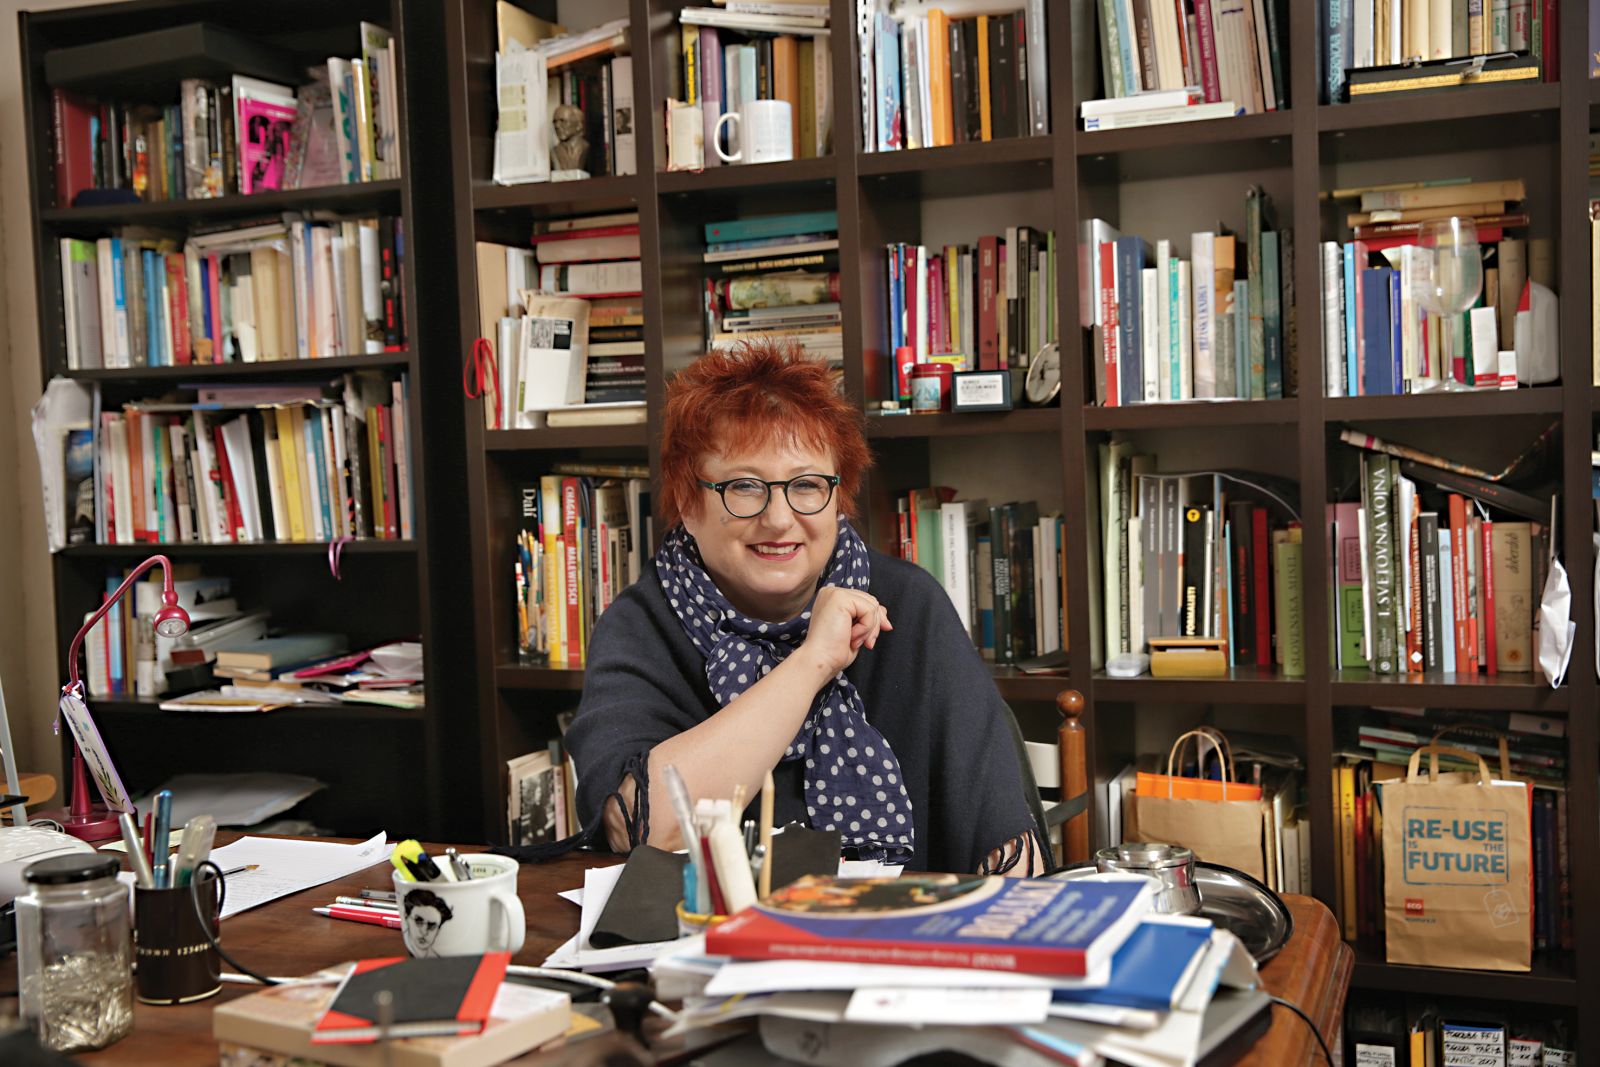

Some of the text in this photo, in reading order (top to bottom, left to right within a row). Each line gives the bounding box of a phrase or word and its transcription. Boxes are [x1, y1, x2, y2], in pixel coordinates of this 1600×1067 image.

[522, 488, 537, 518] Dalí
[565, 486, 576, 525] CHAGALL
[1373, 468, 1388, 520] VOJNA
[567, 546, 578, 605] MALEWITSCH
[1376, 522, 1390, 605] SVETOVNA
[1186, 586, 1197, 636] FORMALISTI
[1408, 818, 1504, 841] RE-USE
[1408, 841, 1504, 852] IS THE
[1408, 851, 1505, 873] FUTURE
